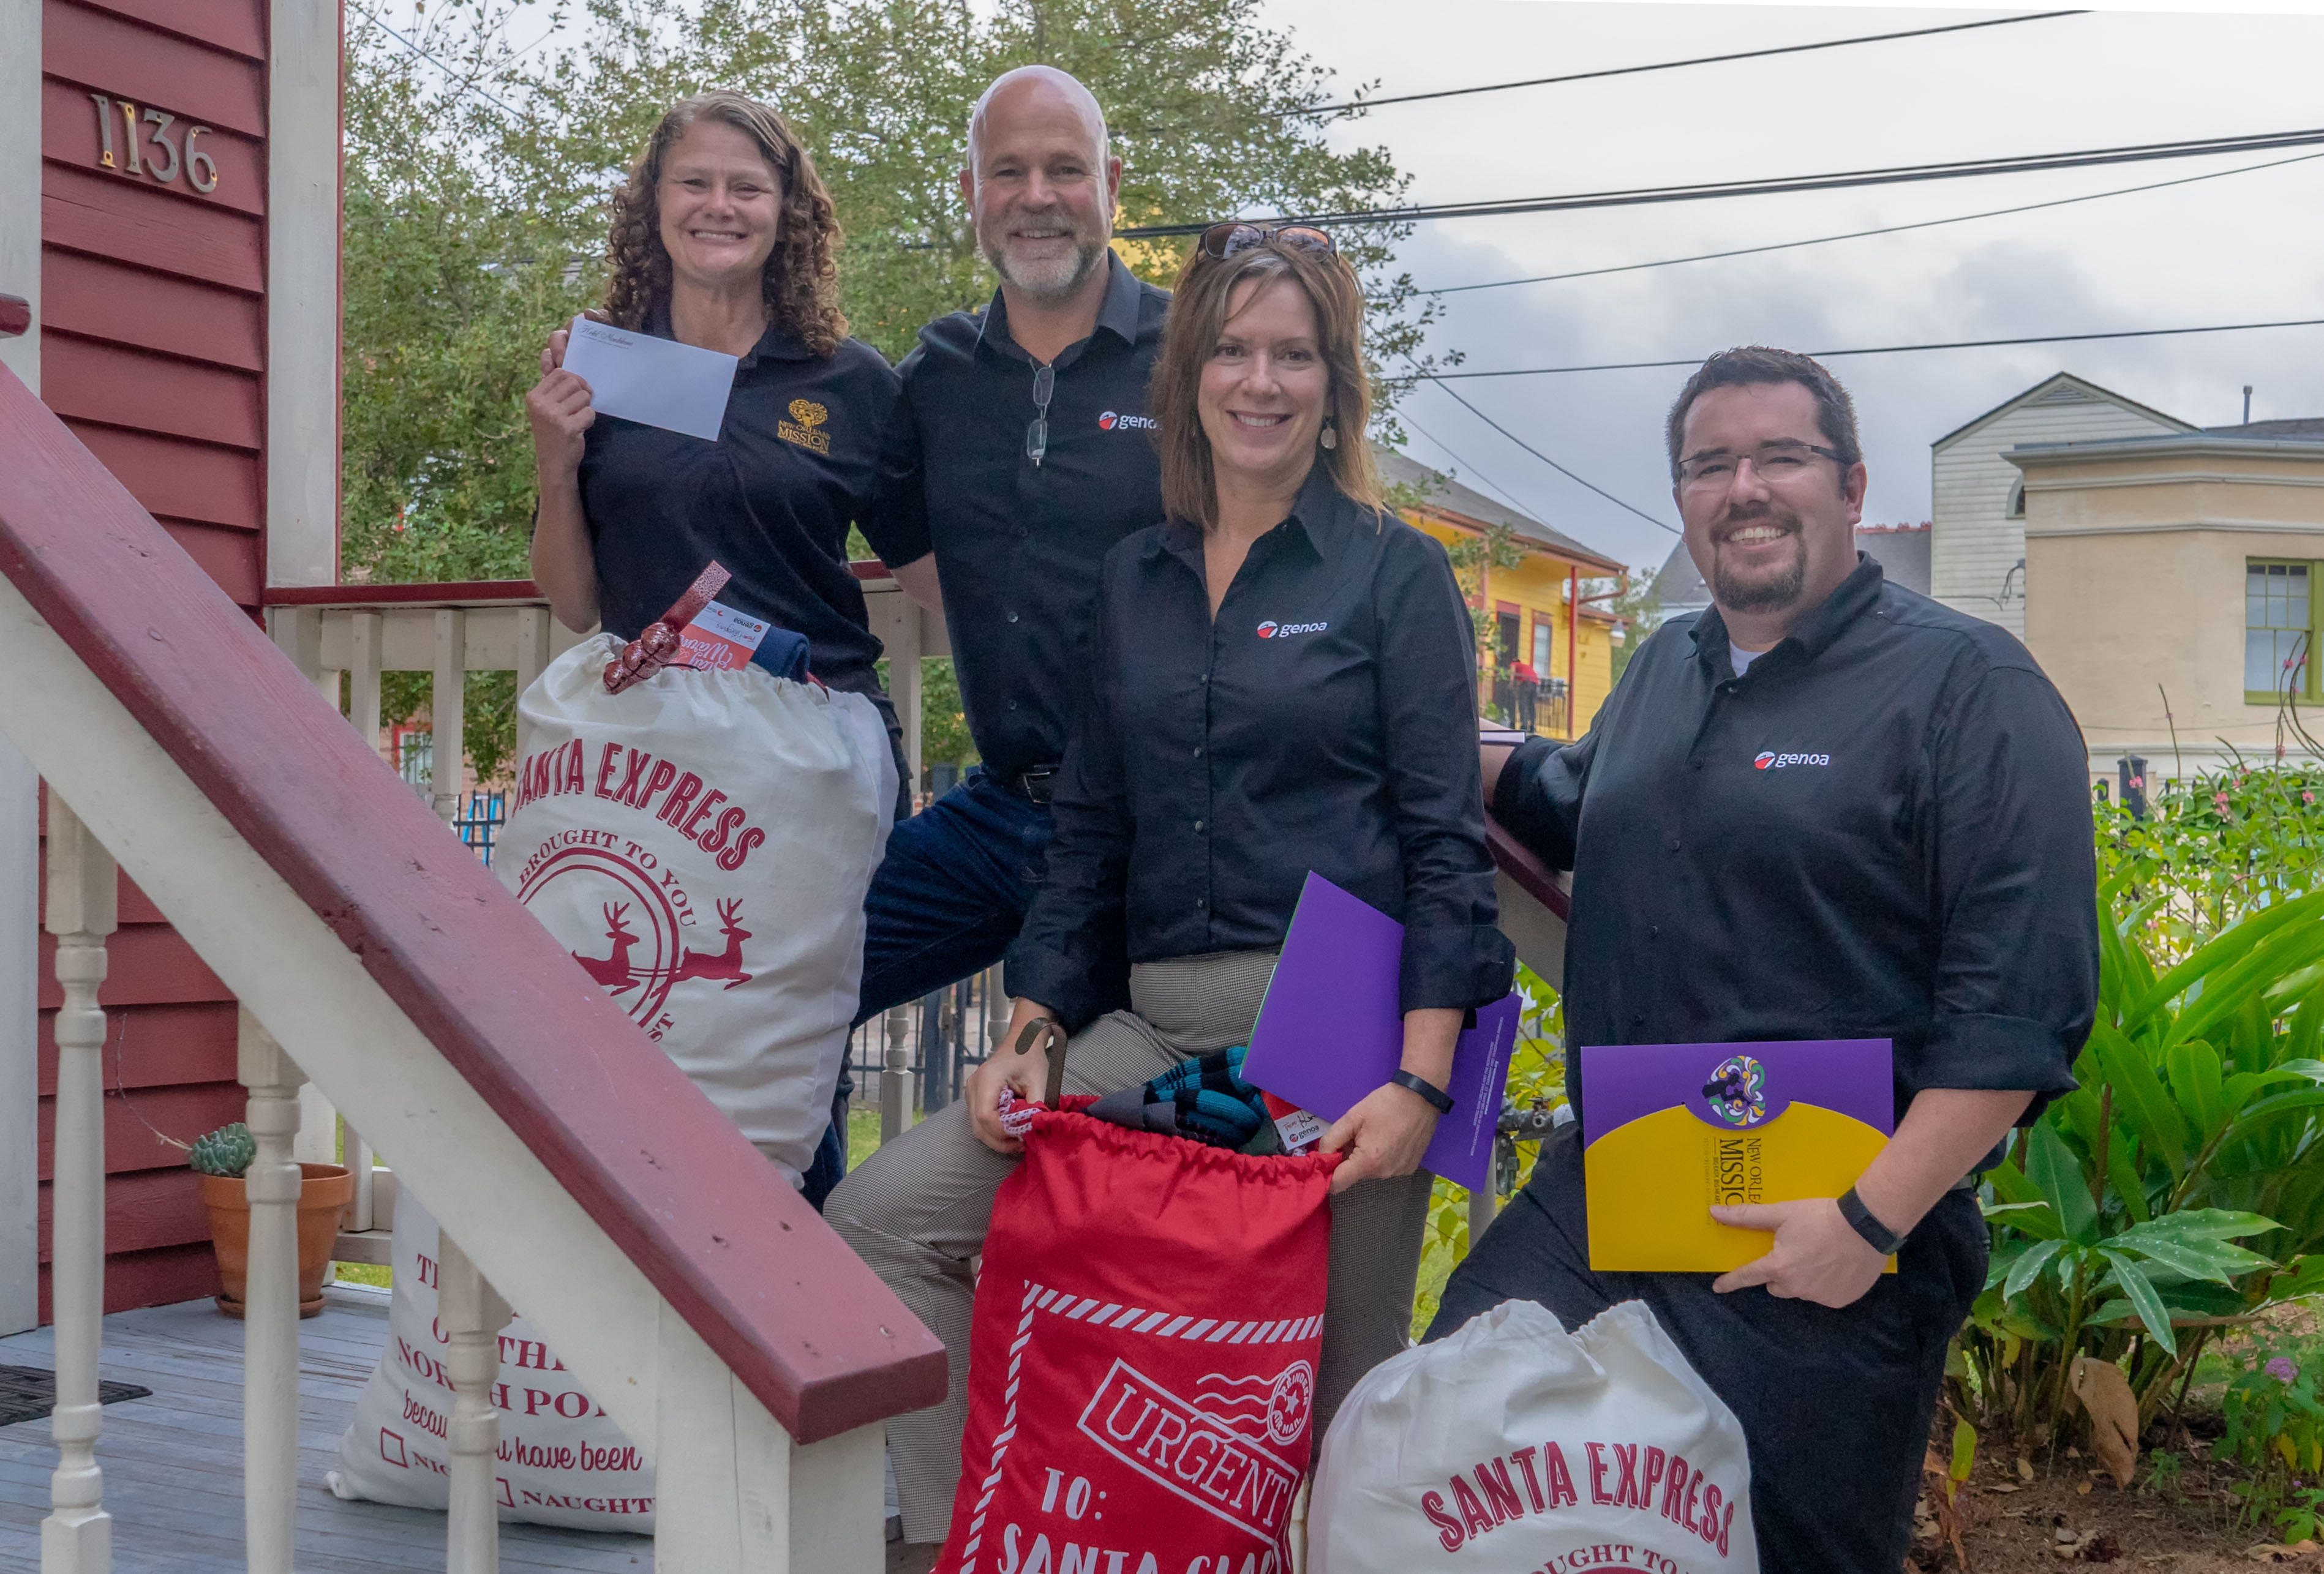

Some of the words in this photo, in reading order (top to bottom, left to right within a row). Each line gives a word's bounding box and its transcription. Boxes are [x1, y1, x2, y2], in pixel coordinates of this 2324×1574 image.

[91, 94, 217, 193] 1136
[1118, 415, 1157, 430] geno
[778, 427, 830, 452] MISSION
[734, 617, 754, 629] genoa
[1279, 621, 1328, 637] genoa
[687, 652, 721, 671] tay
[1775, 753, 1830, 768] genoa
[595, 741, 765, 871] EXPRESS
[519, 829, 619, 885] BROUGHT
[625, 841, 658, 869] TO
[660, 868, 696, 927] YOU
[1298, 1125, 1320, 1139] genoa
[1747, 1137, 1762, 1164] NEW
[1719, 1138, 1745, 1207] MISSIO
[498, 1335, 568, 1371] TH
[397, 1335, 512, 1411] NORH
[523, 1388, 607, 1418] PO
[403, 1389, 448, 1440] becau
[516, 1436, 576, 1471] have
[581, 1440, 642, 1471] been
[412, 1451, 451, 1477] NIC
[1106, 1383, 1290, 1527] URGENT
[520, 1490, 656, 1514] NAUGHT
[1042, 1467, 1107, 1520] TO:
[1421, 1441, 1578, 1553] SANTA
[1584, 1441, 1734, 1558] EXPRESS
